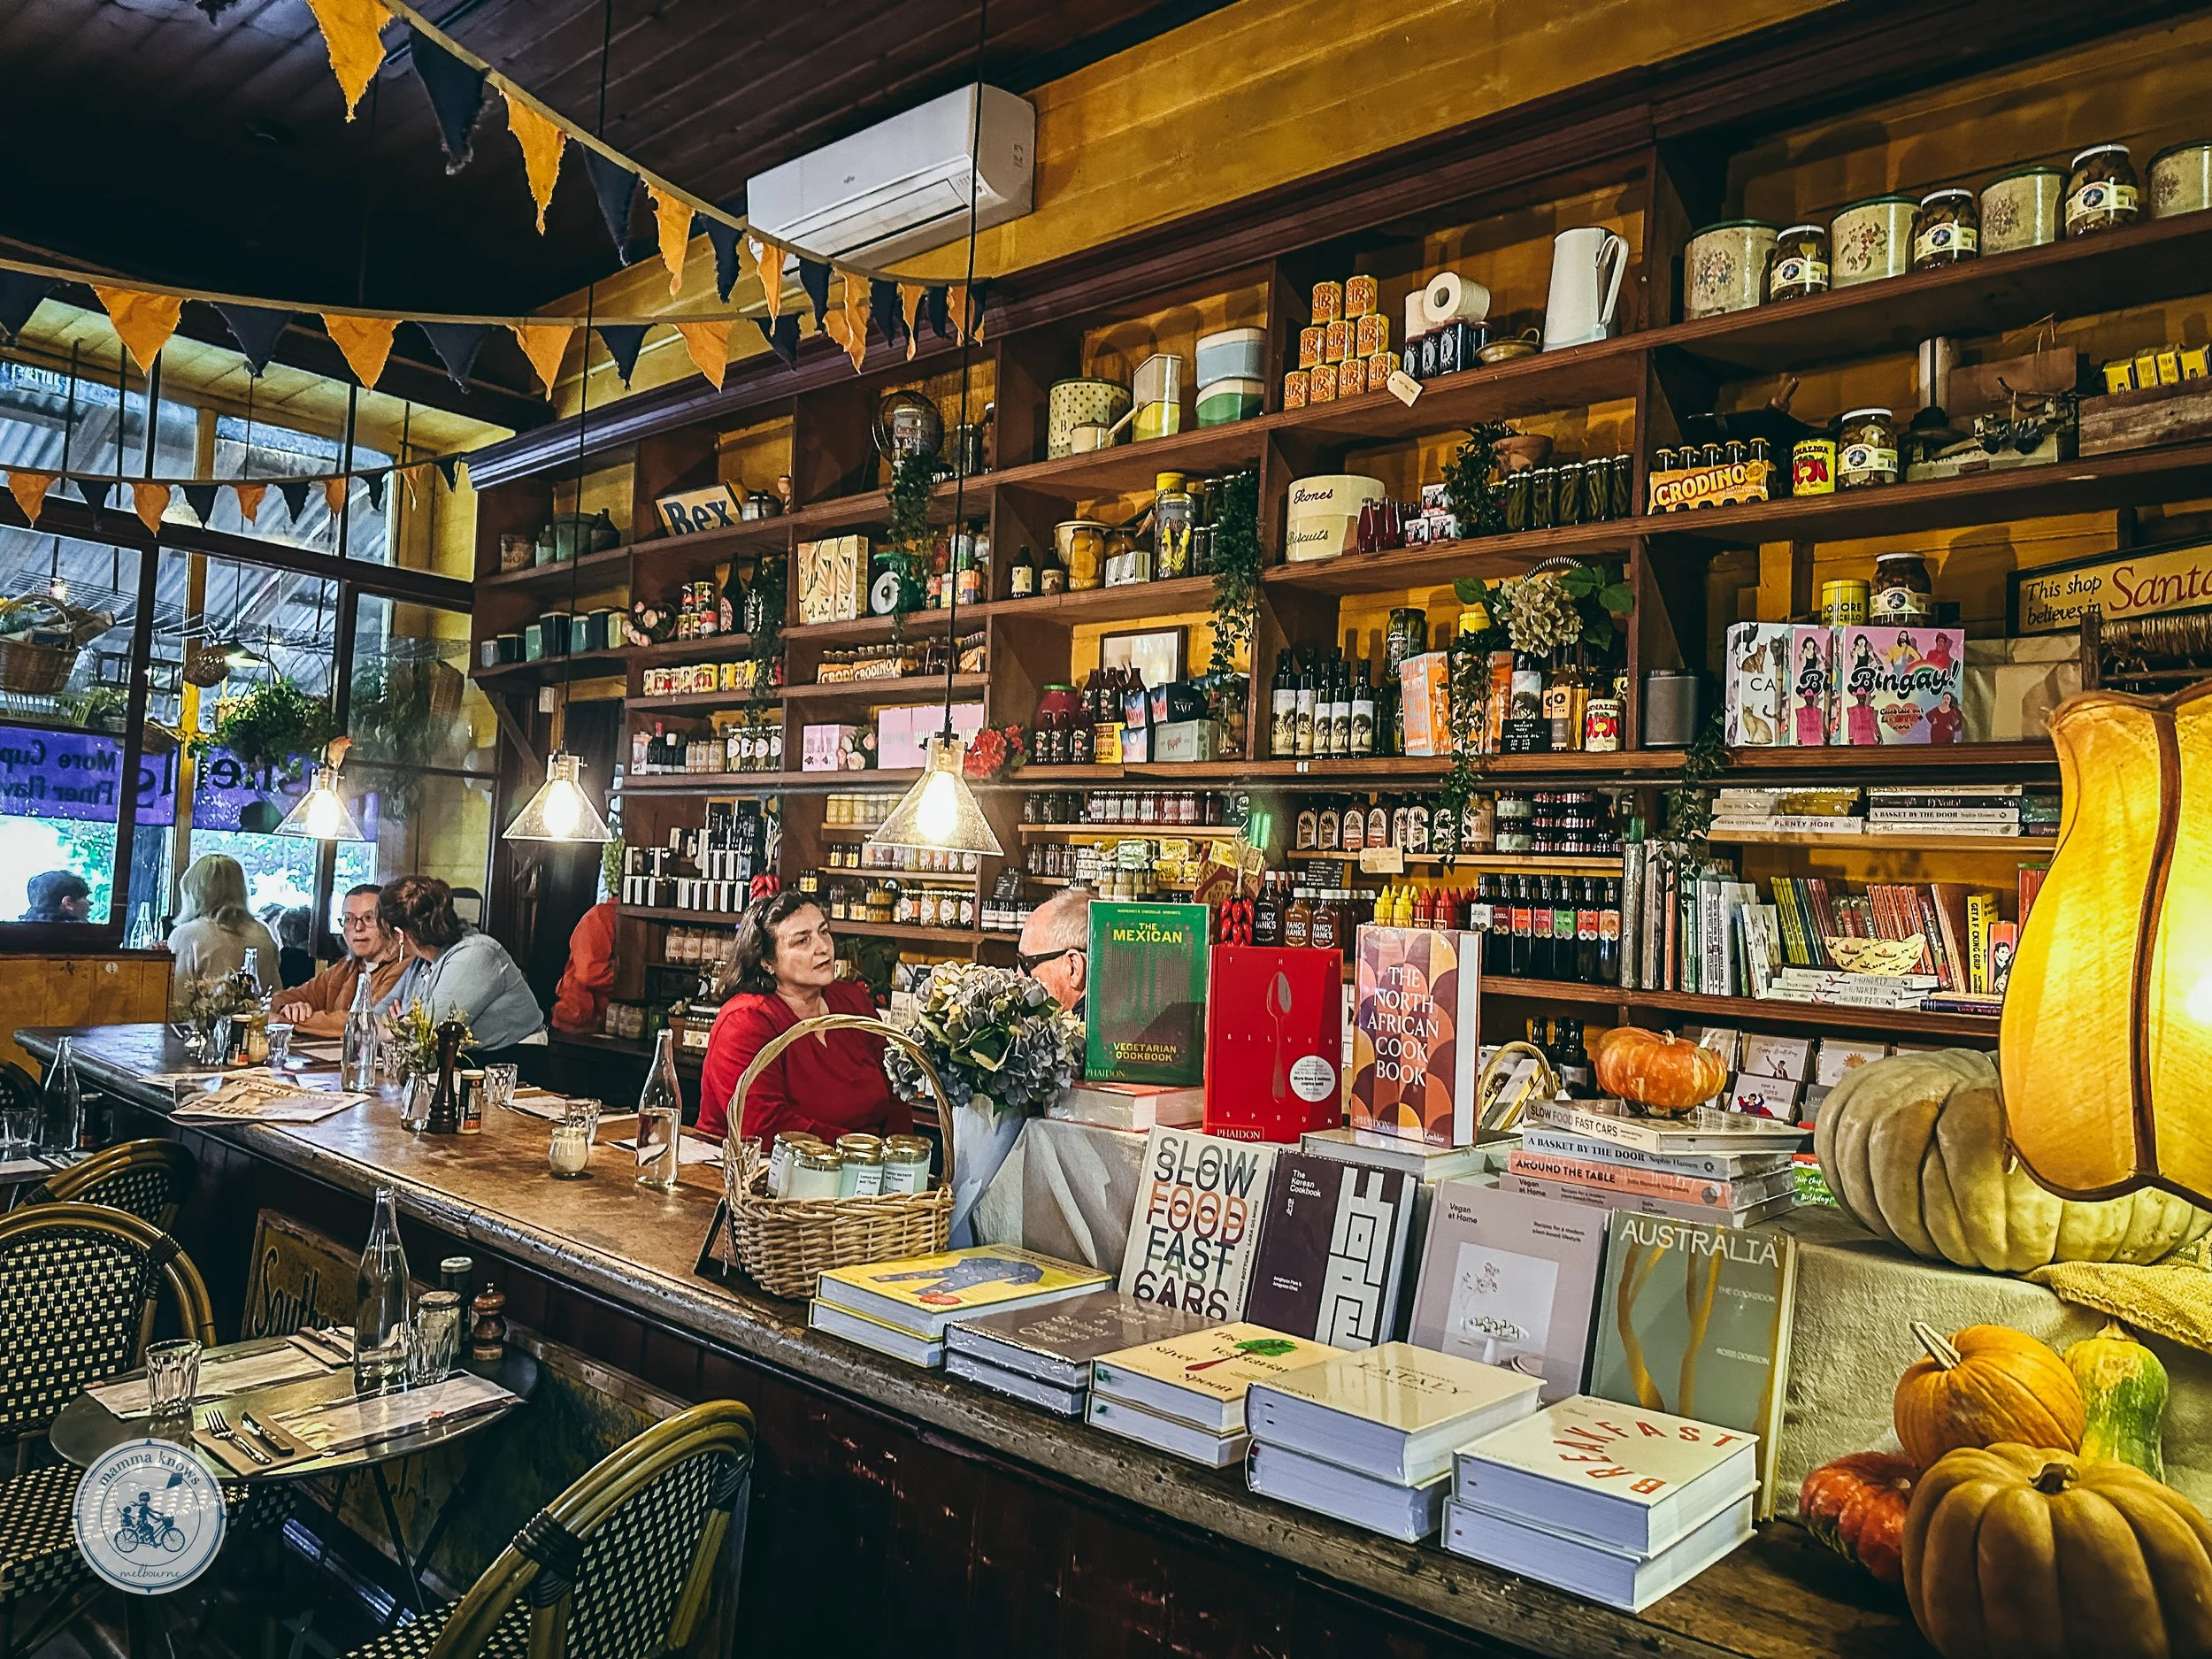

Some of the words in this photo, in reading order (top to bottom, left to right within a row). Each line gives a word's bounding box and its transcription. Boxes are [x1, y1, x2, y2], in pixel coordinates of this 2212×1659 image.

[1655, 464, 1747, 506] CRODINO
[1294, 488, 1333, 505] Scones
[2025, 580, 2061, 602] This
[2066, 574, 2102, 595] shop
[2027, 603, 2083, 626] believes
[2088, 598, 2102, 614] in
[854, 661, 892, 681] CRODINO
[1847, 660, 1961, 700] Bingay!
[1257, 912, 1276, 922] ANCY
[1138, 922, 1157, 931] THE
[1113, 929, 1183, 943] MEXICAN
[1387, 966, 1421, 988] THE
[1373, 988, 1434, 1014] NORTH
[1367, 1011, 1440, 1040] AFRICAN
[1113, 1042, 1177, 1054] VEGETARIAN
[1116, 1050, 1172, 1062] COOKBOOK
[1375, 1036, 1429, 1063] COOK
[1086, 1067, 1125, 1078] PHAIDON
[1376, 1059, 1426, 1087] BOOK
[1225, 1111, 1333, 1125] SPOON
[1356, 1115, 1391, 1131] PHAIDON
[1531, 1105, 1552, 1120] SLOW
[1552, 1110, 1574, 1125] FOOD
[1575, 1116, 1594, 1133] FAST
[1595, 1121, 1618, 1138] CARS
[1217, 1128, 1261, 1140] PHAIDON
[1528, 1137, 1535, 1146] A
[1537, 1138, 1574, 1152] BASKET
[1577, 1143, 1590, 1154] BY
[1592, 1146, 1612, 1158] THE
[1615, 1149, 1645, 1162] DOOR
[1154, 1137, 1259, 1199] SLOW
[1293, 1169, 1306, 1180] The
[1516, 1158, 1561, 1174] AROUND
[1563, 1166, 1584, 1179] THE
[1586, 1170, 1616, 1184] TABLE
[1289, 1184, 1322, 1198] Cookbook
[1291, 1178, 1316, 1189] Korean
[1518, 1178, 1540, 1188] Vegan
[1527, 1187, 1547, 1197] Home
[1146, 1180, 1248, 1245] FOOD
[1449, 1202, 1471, 1214] Vegan
[1456, 1213, 1478, 1225] Home
[1619, 1219, 1779, 1269] AUSTRALIA
[1718, 1285, 1731, 1294] THE
[1150, 1345, 1198, 1362] Silver
[1737, 1351, 1770, 1366] DOBSON
[1179, 1372, 1233, 1393] Spoon
[1553, 1420, 1742, 1495] BREAKFAST
